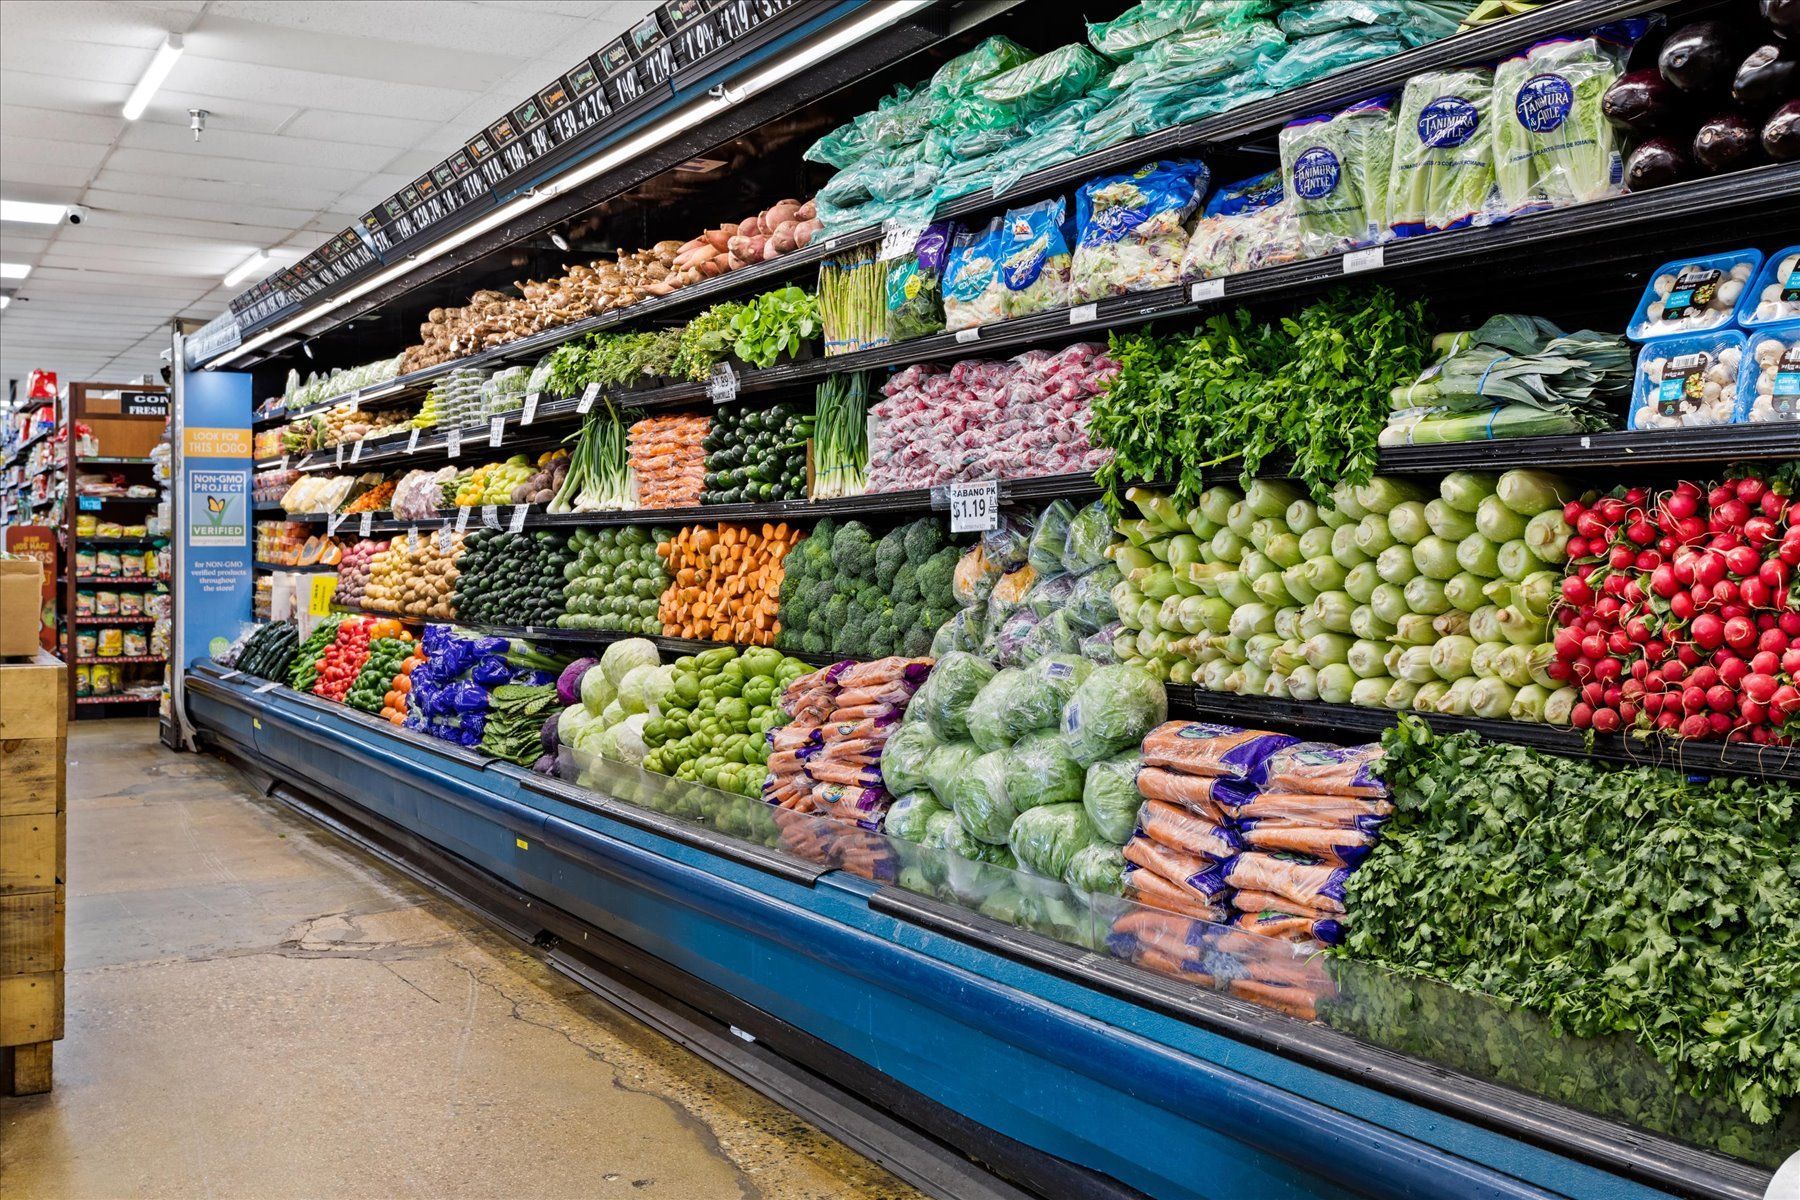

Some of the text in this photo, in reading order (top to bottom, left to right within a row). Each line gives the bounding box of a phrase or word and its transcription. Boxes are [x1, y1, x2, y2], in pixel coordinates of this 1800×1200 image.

[1517, 92, 1569, 119] TANIMURA
[1420, 113, 1474, 135] TANIMURA
[1530, 117, 1537, 126] &
[1295, 164, 1338, 186] TANIMURA
[1300, 176, 1332, 196] ANTLE
[129, 406, 166, 415] FRESH
[193, 432, 240, 441] LOOK FOR
[189, 442, 248, 454] THIS LOGO
[194, 474, 243, 484] NON-GMO
[194, 483, 243, 492] PROJECT
[986, 486, 996, 495] PK
[953, 498, 986, 521] $1.19
[193, 526, 242, 535] VERIFIED
[217, 569, 247, 578] products
[199, 577, 236, 586] throughout
